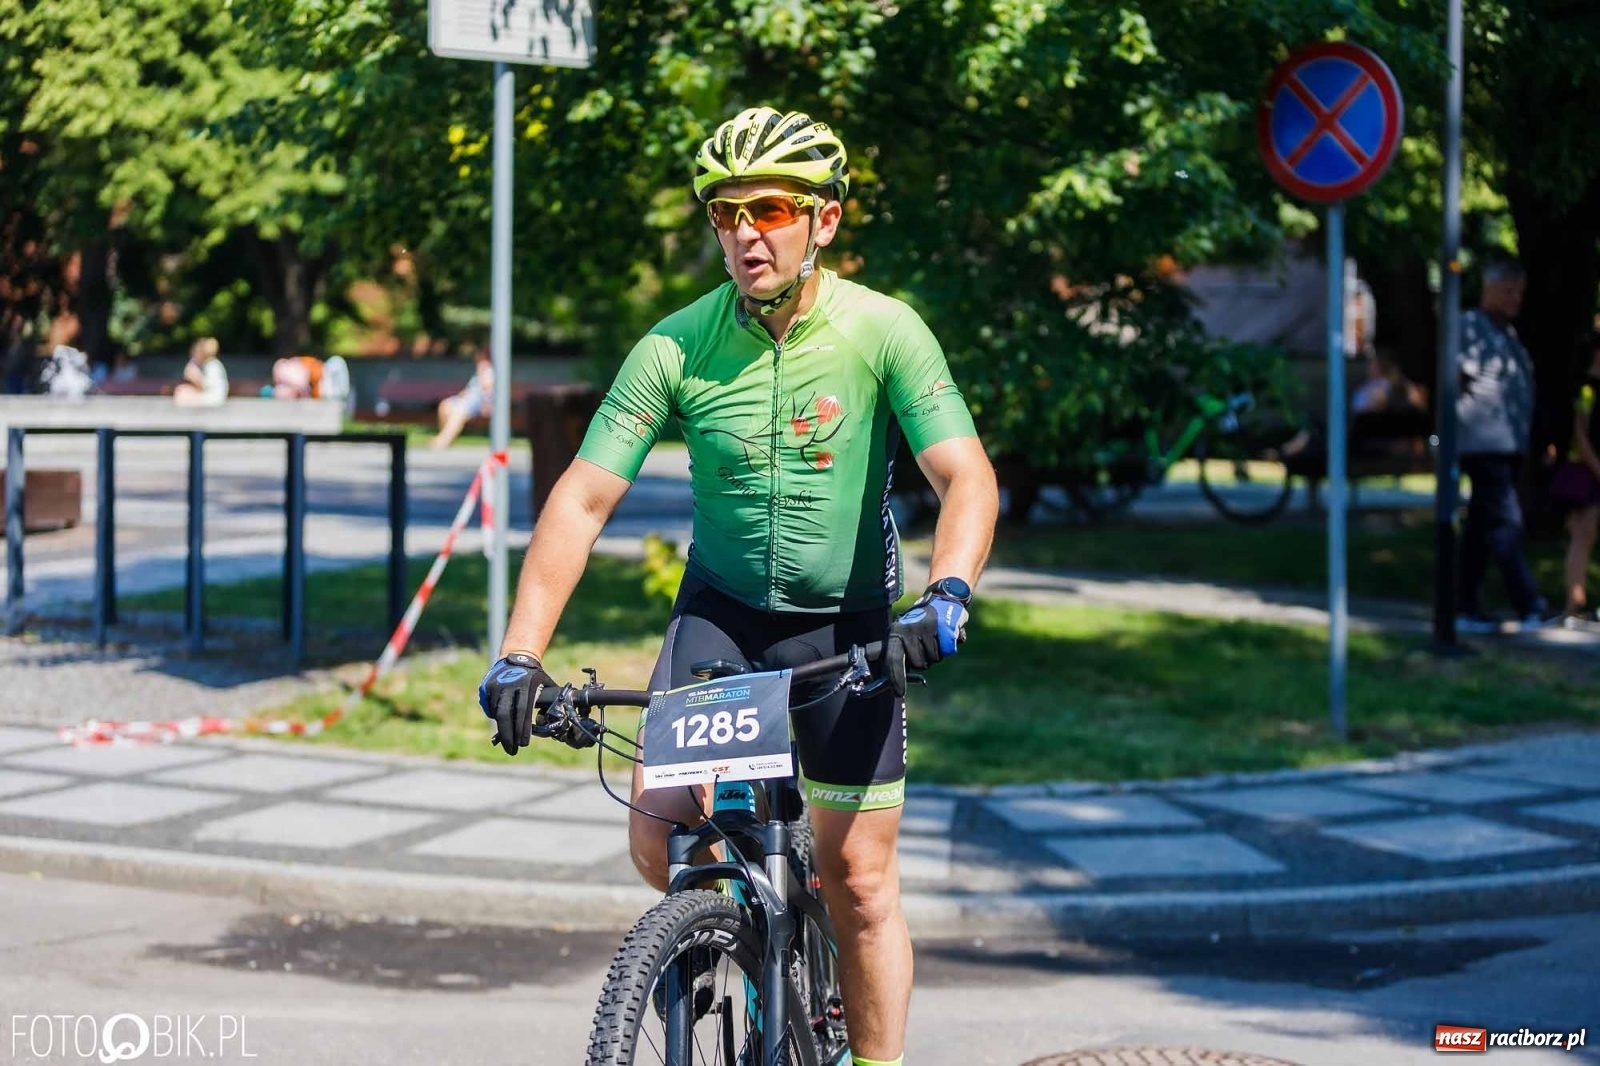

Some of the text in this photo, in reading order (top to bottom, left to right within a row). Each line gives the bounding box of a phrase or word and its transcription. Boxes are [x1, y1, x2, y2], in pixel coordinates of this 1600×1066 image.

[885, 532, 896, 589] LYSKI
[671, 707, 760, 749] 1285
[717, 789, 748, 802] KTM
